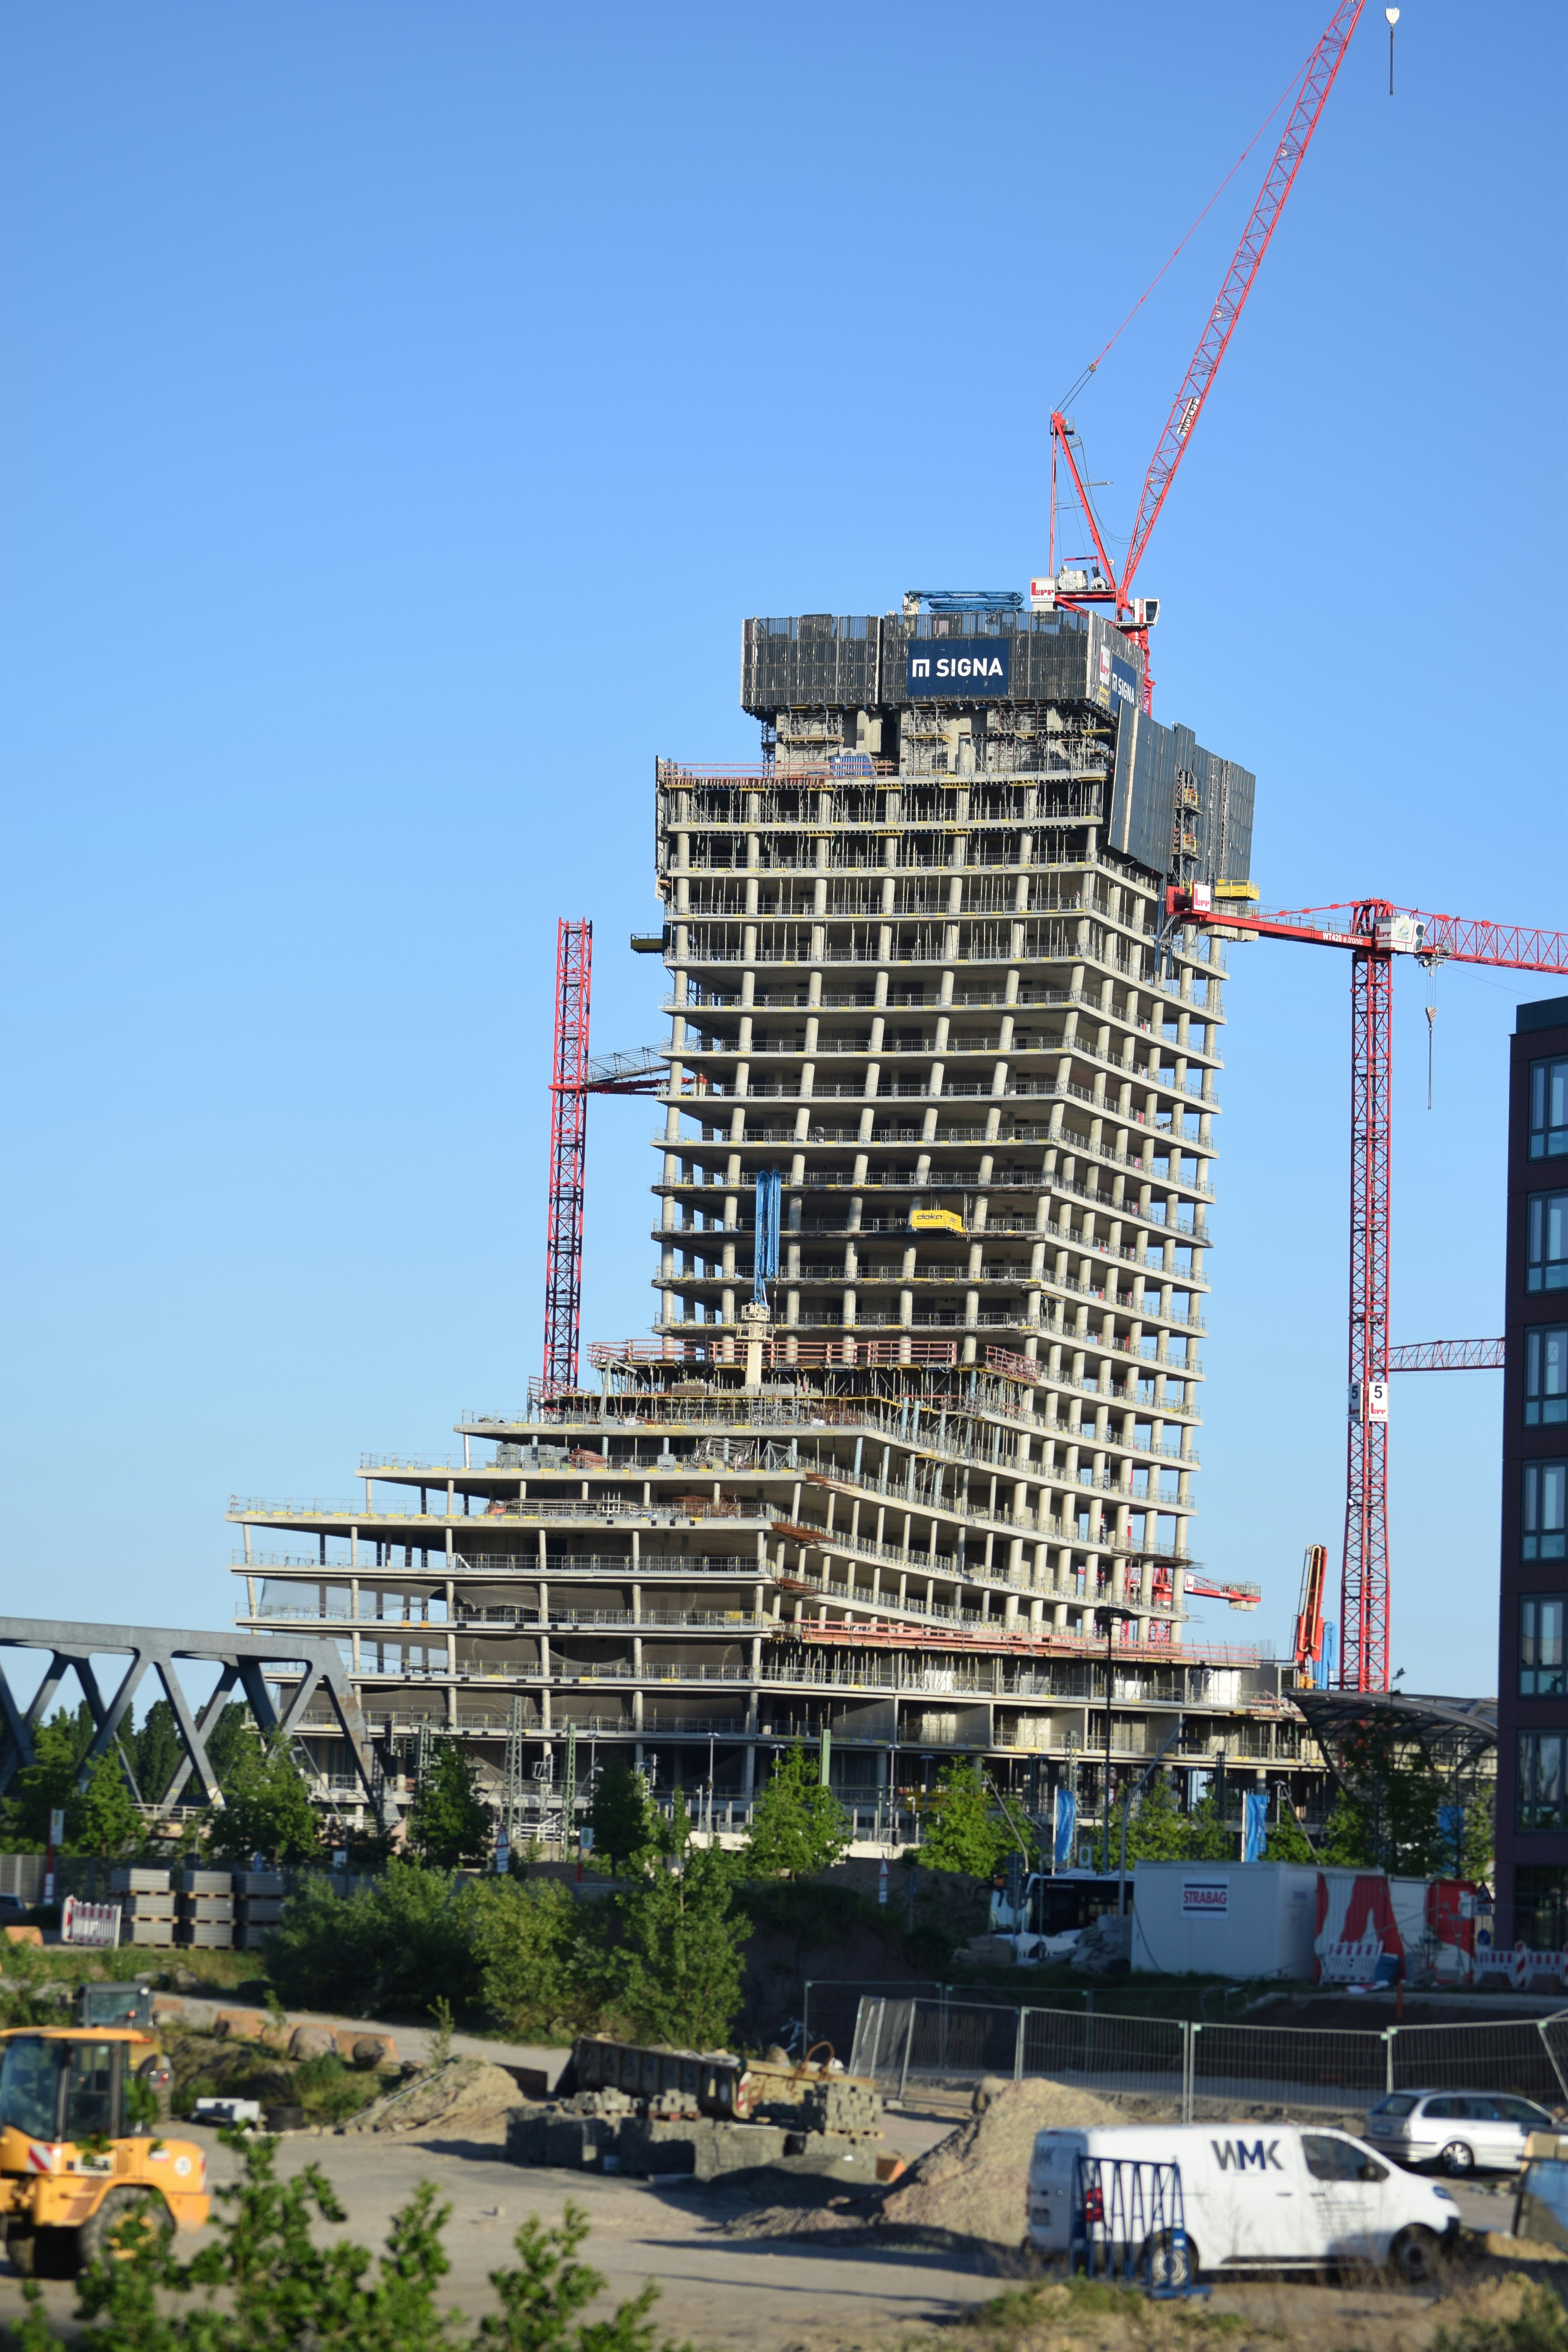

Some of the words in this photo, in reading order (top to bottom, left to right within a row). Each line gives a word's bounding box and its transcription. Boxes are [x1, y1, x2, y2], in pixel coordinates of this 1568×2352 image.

[1180, 397, 1198, 434] WOLFF
[936, 658, 1003, 677] SIGNA
[1118, 677, 1134, 706] SIGNA
[1323, 932, 1342, 942] WT420
[1343, 936, 1363, 945] e.tronic
[1351, 1385, 1358, 1399] 5
[1374, 1385, 1383, 1399] 5
[1183, 1891, 1227, 1905] STRABAG
[1211, 2140, 1284, 2170] WMK
